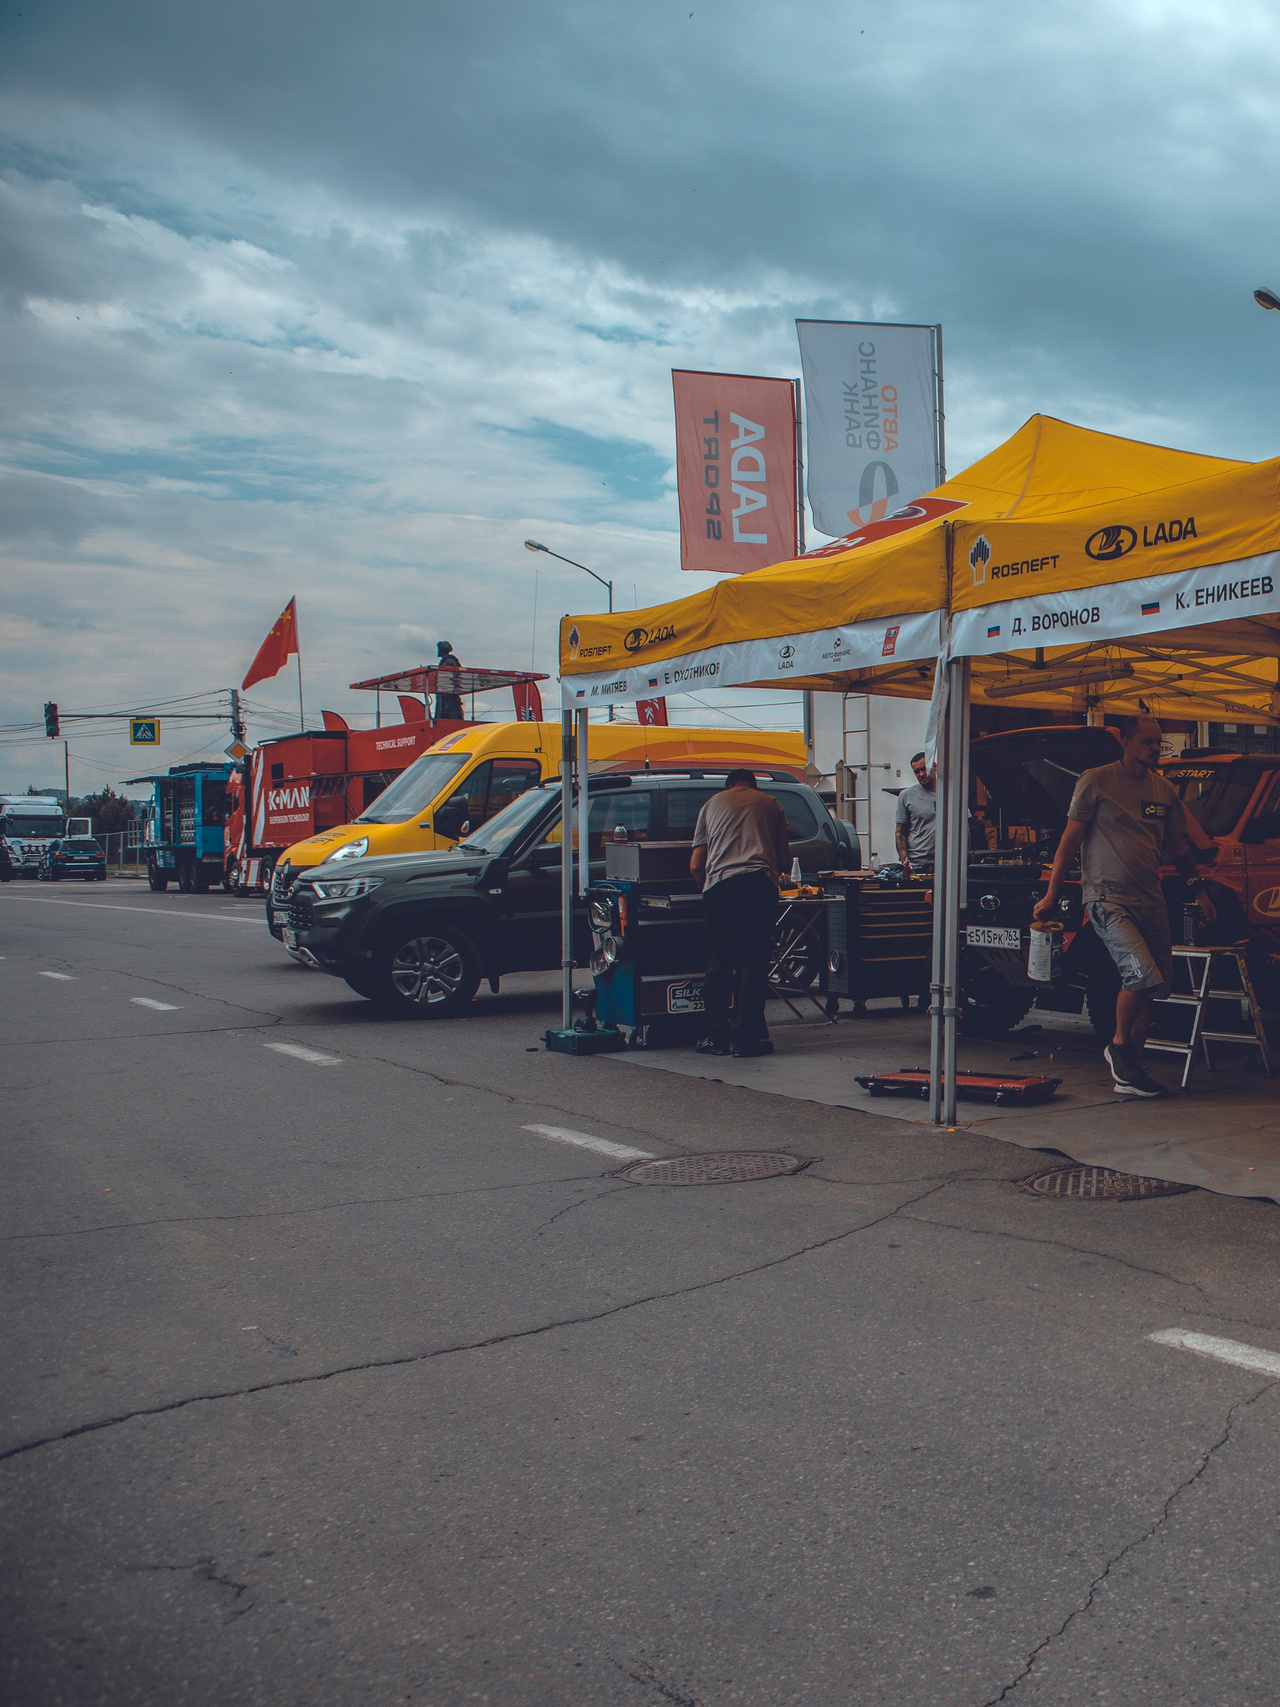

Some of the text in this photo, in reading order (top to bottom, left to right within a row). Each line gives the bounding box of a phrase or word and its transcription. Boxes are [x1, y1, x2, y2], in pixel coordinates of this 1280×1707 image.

[1143, 517, 1198, 547] LADA
[991, 555, 1060, 580] ROSNEFT
[1175, 576, 1274, 610] К. ЕНИКЕЕВ
[1011, 606, 1100, 637] Д. ВОРОНОВ
[648, 625, 677, 643] LADA
[578, 645, 612, 658] ROSNEFT
[674, 662, 720, 683] ОХОТНИКОВ
[778, 661, 794, 670] LADA
[601, 681, 628, 696] МИТЯЕВ
[375, 736, 416, 751] TECHNICAL SUPPORT
[1177, 769, 1215, 778] START
[675, 988, 701, 998] SILK
